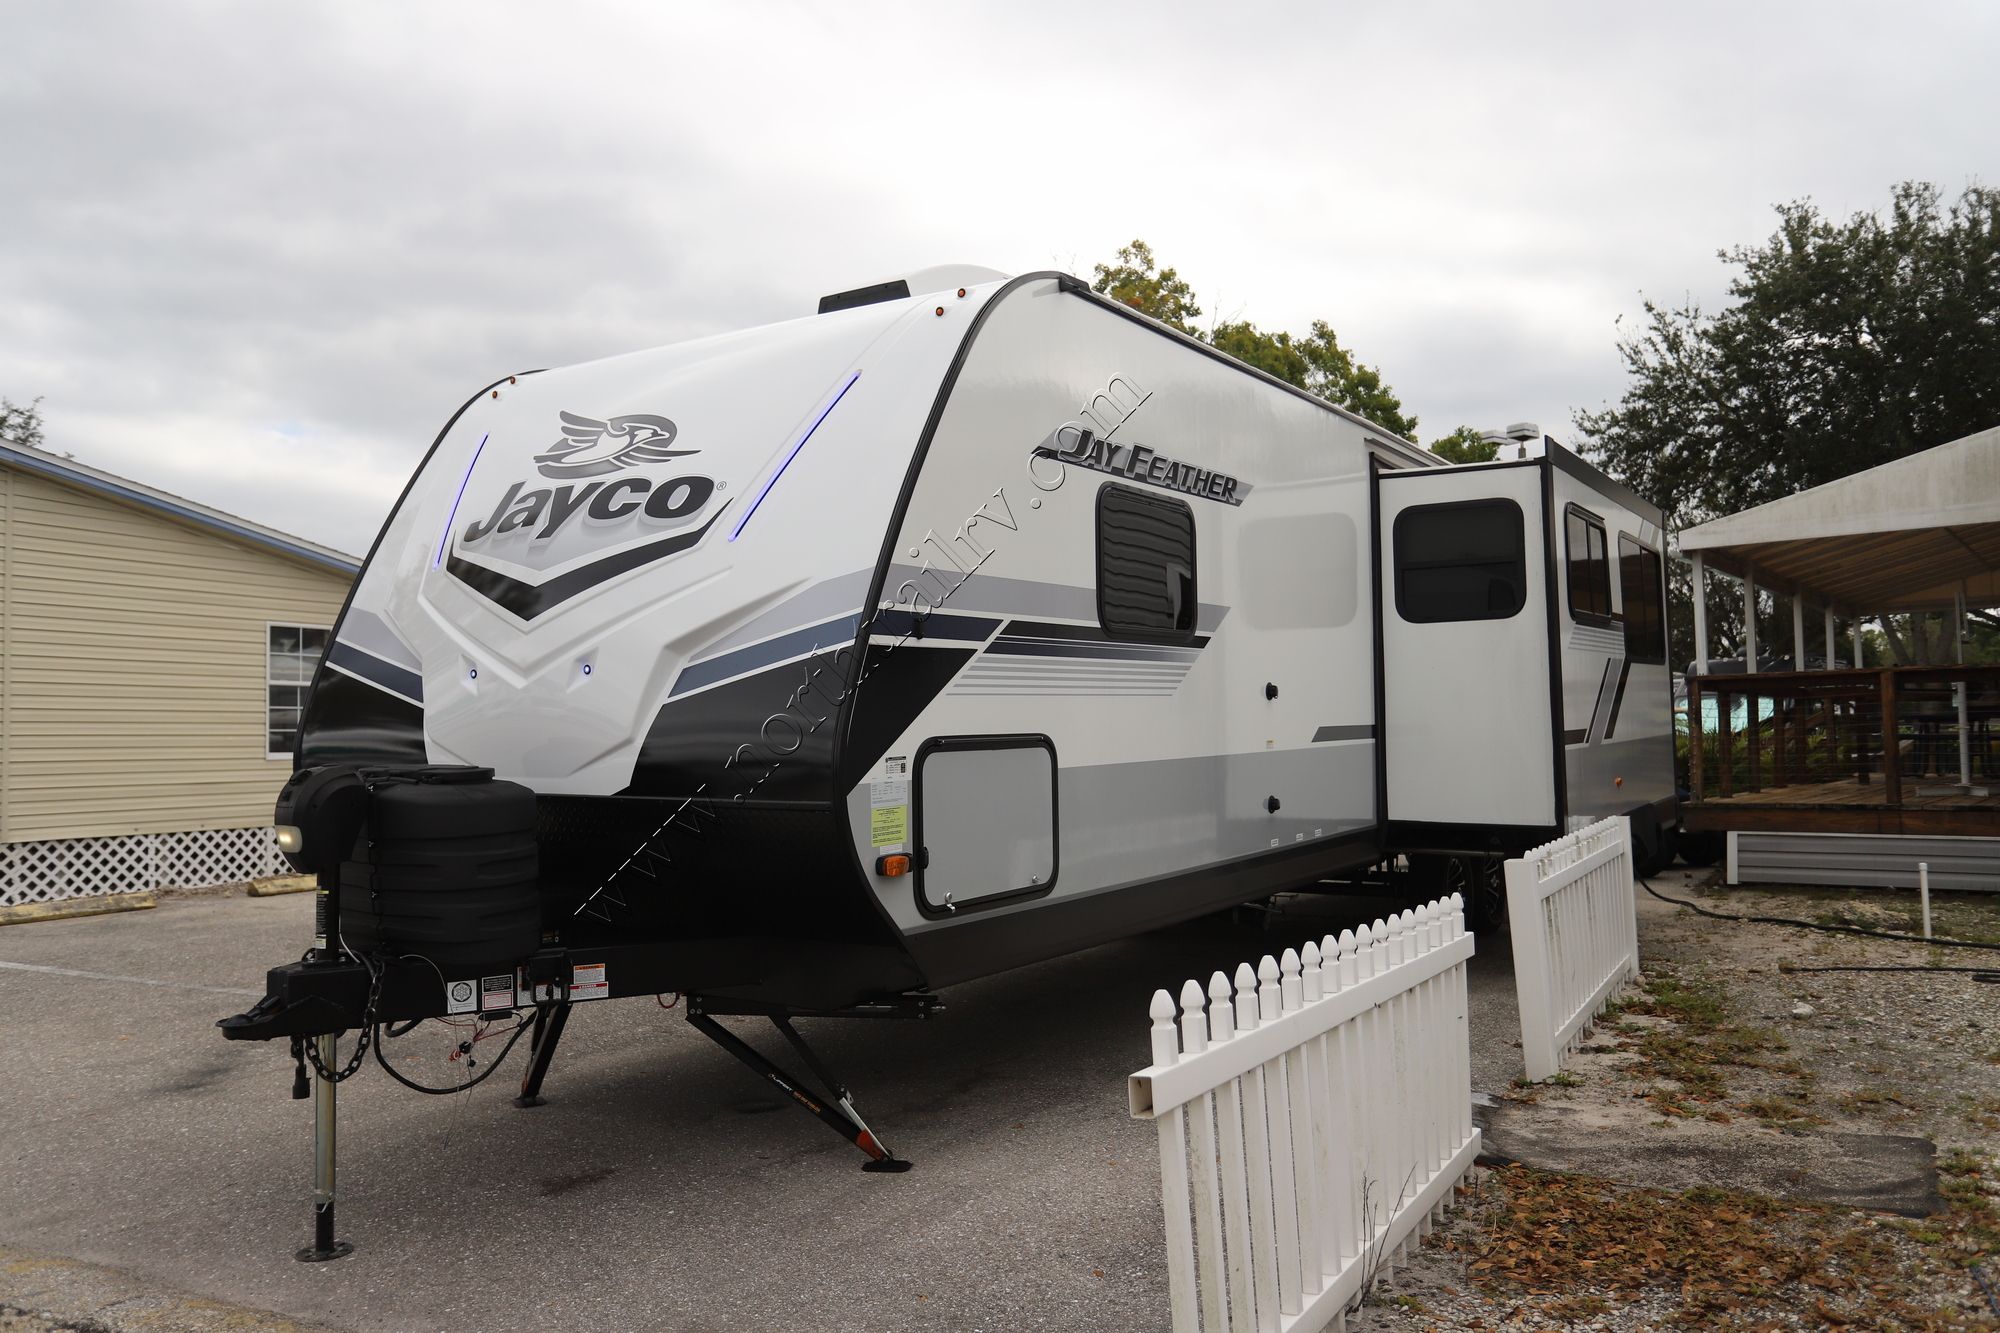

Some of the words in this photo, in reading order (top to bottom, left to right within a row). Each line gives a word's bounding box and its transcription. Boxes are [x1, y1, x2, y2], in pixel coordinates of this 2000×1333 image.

[1058, 428, 1122, 471] JAY
[1124, 442, 1239, 503] FEATHER
[462, 474, 715, 544] Jayco
